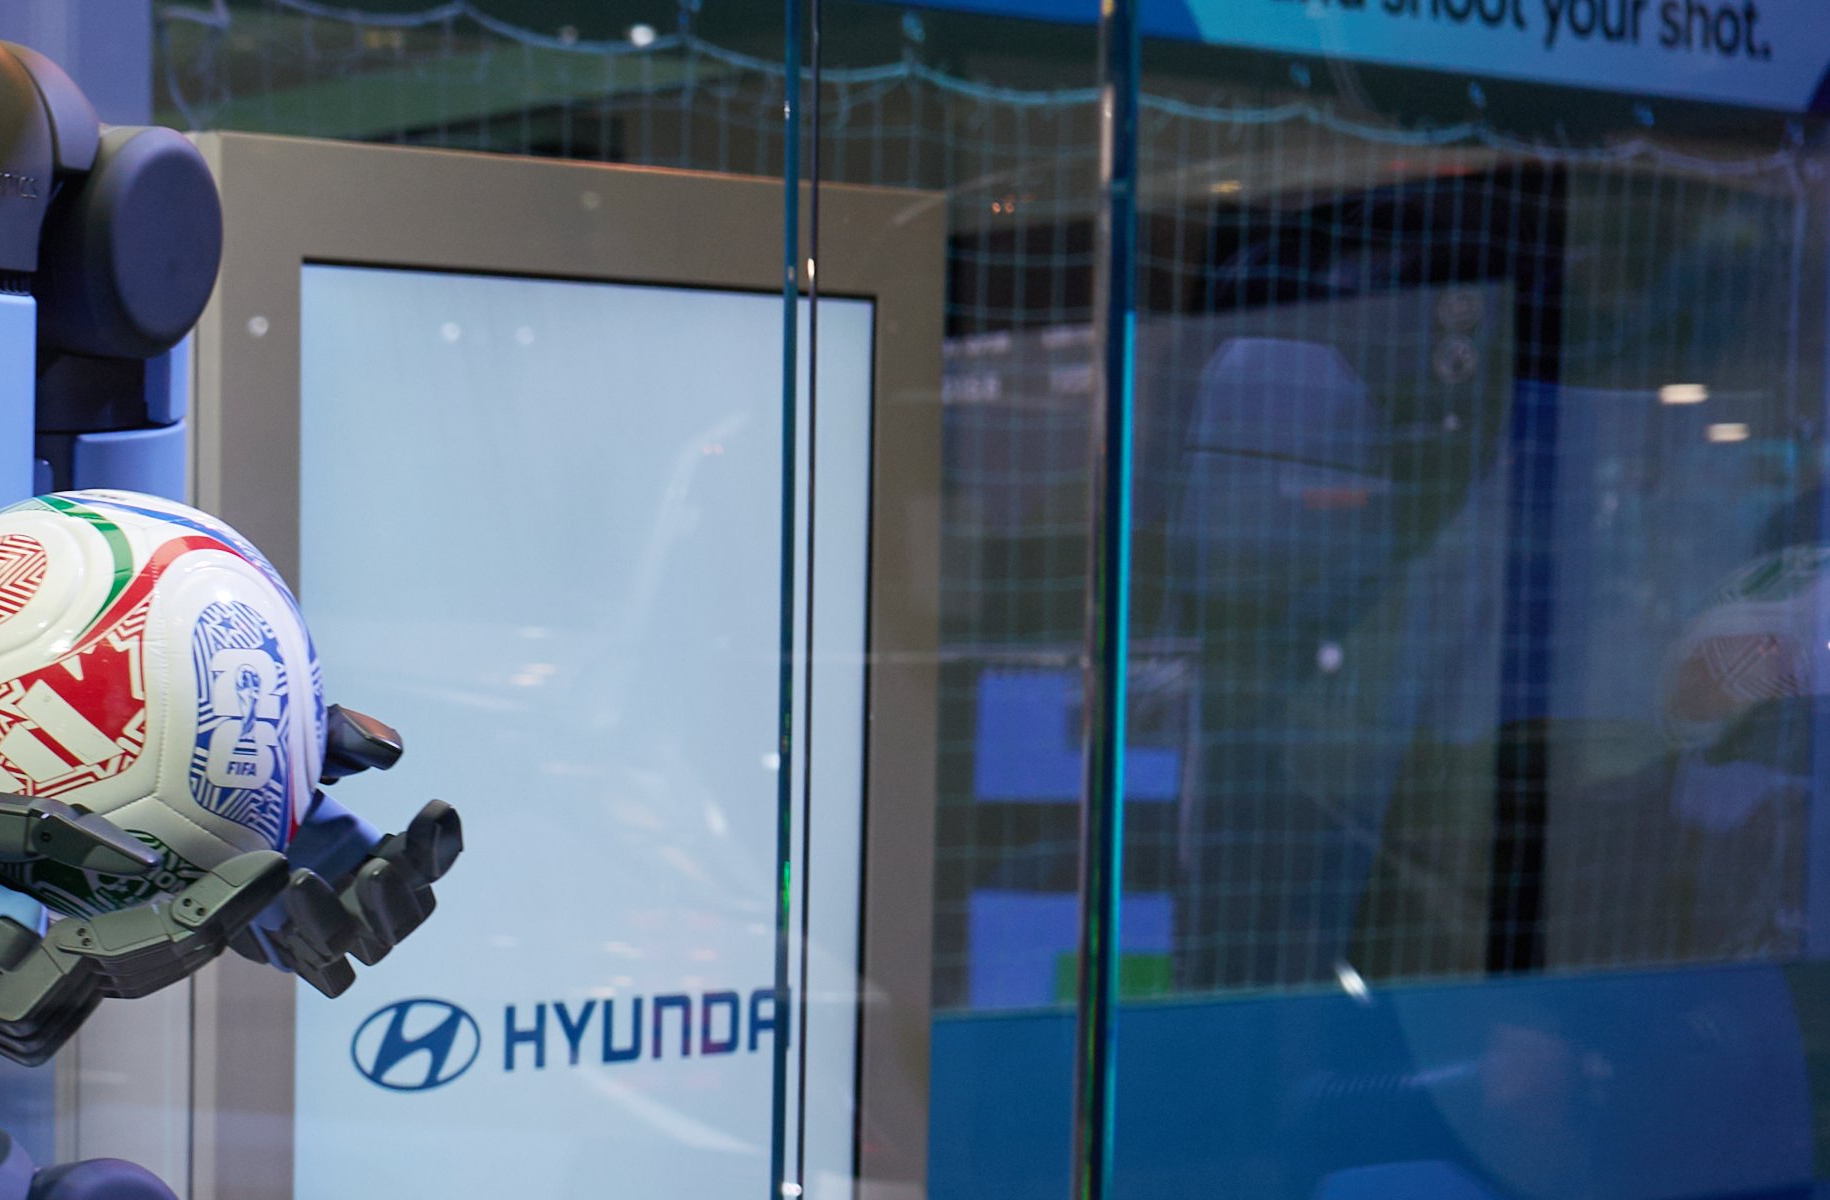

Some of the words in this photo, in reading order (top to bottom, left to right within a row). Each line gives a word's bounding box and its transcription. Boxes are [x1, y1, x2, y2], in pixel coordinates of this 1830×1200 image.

[1542, 0, 1646, 50] your
[1659, 0, 1773, 60] shot.
[226, 760, 258, 777] FIFA
[503, 985, 795, 1072] HYUNDA
